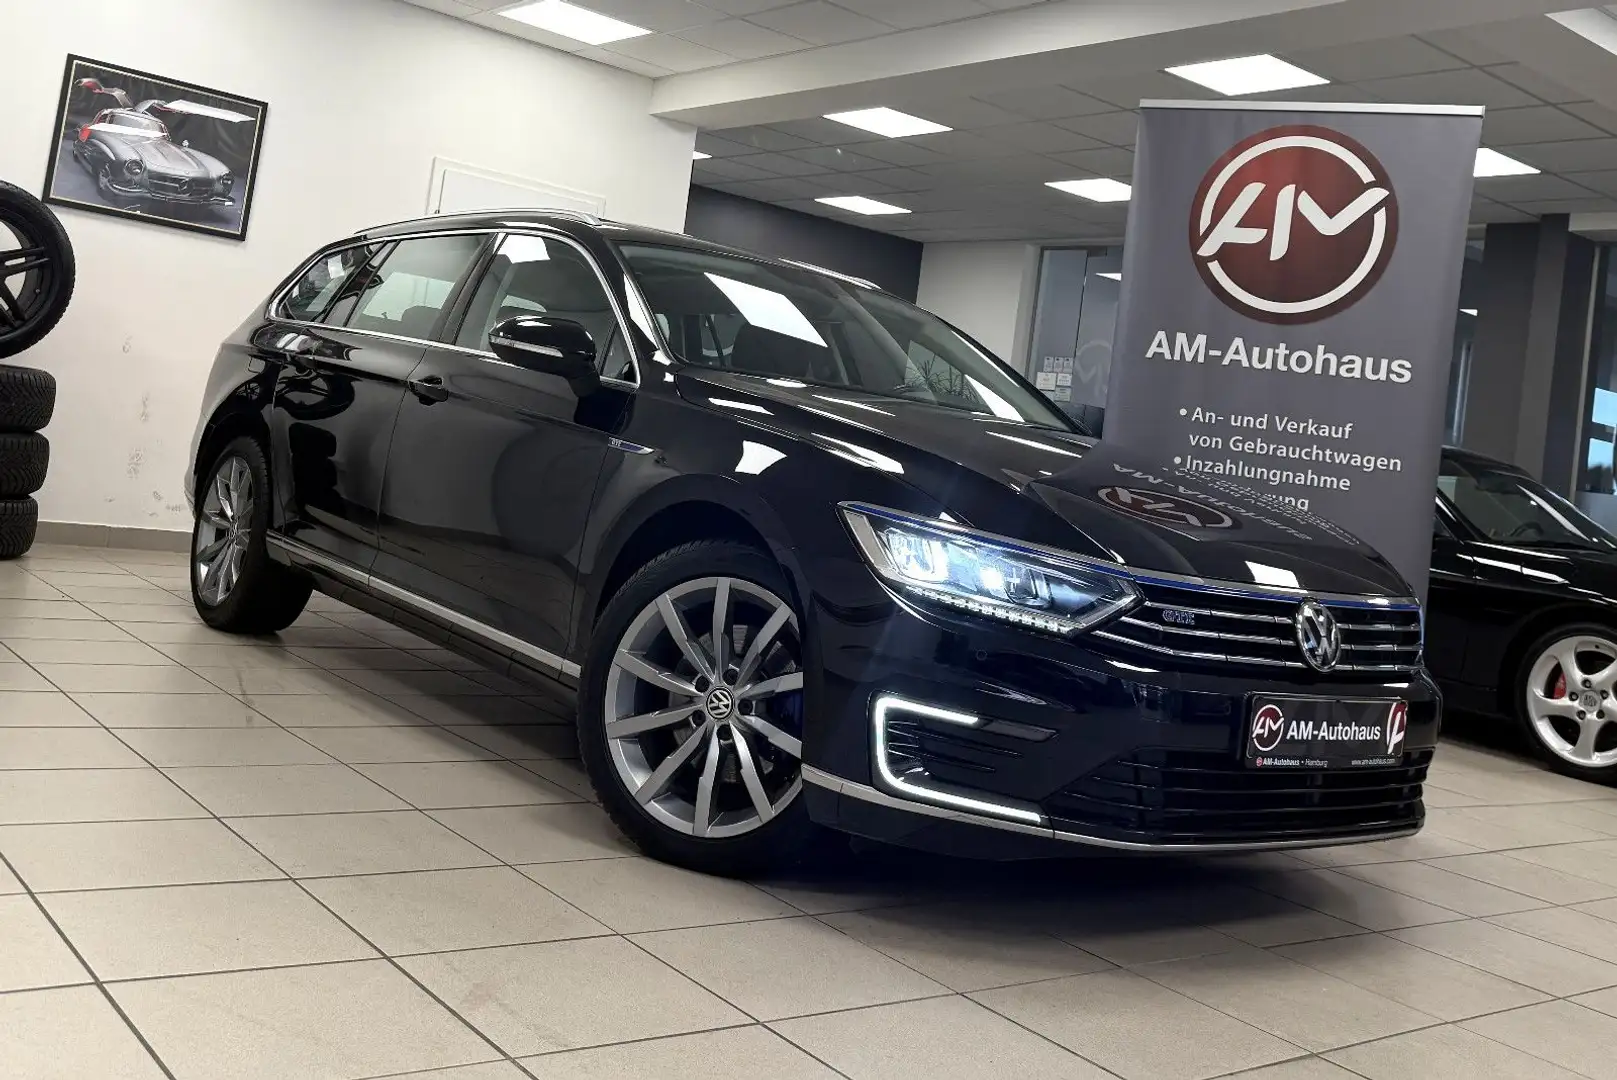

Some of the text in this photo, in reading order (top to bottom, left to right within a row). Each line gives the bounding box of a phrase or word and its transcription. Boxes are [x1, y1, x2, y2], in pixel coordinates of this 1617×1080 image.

[1145, 330, 1413, 384] AM-Autohaus
[1191, 406, 1354, 439] An- und Verkauf
[1189, 433, 1402, 472] von Gebrauchtwagen
[1186, 455, 1351, 491] Inzahlungnahme
[1286, 720, 1381, 741] AM-Autohaus
